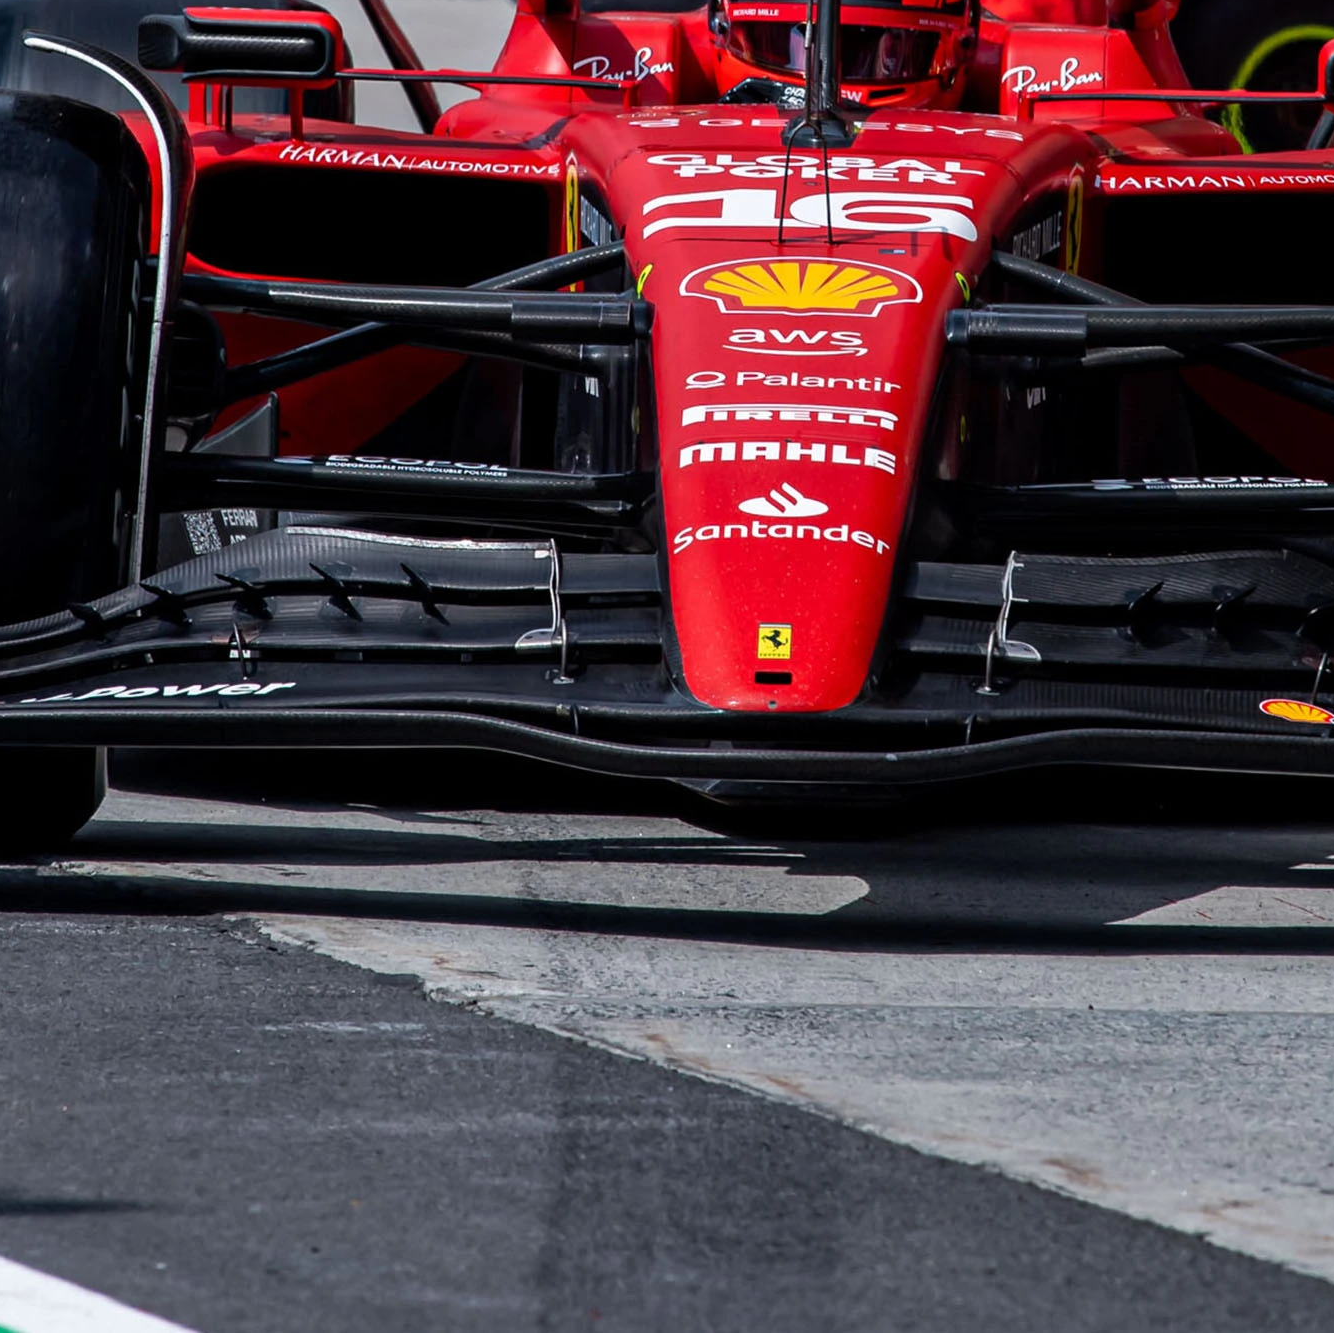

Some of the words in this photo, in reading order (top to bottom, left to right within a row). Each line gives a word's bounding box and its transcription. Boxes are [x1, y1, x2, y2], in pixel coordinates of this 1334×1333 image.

[573, 46, 674, 81] Ray-Ban
[1001, 57, 1103, 93] Ray-Ban
[279, 144, 407, 170] HARMAN
[418, 157, 561, 177] AUTOMOTIVE
[646, 153, 986, 177] GLOBAL
[673, 164, 957, 185] POKER
[1094, 173, 1244, 190] HARMAN
[642, 188, 979, 243] 16
[728, 327, 863, 347] aws
[735, 370, 902, 394] Palantir
[681, 403, 899, 432] PIRELLI
[679, 441, 897, 476] MAHLE
[673, 520, 891, 555] Santander
